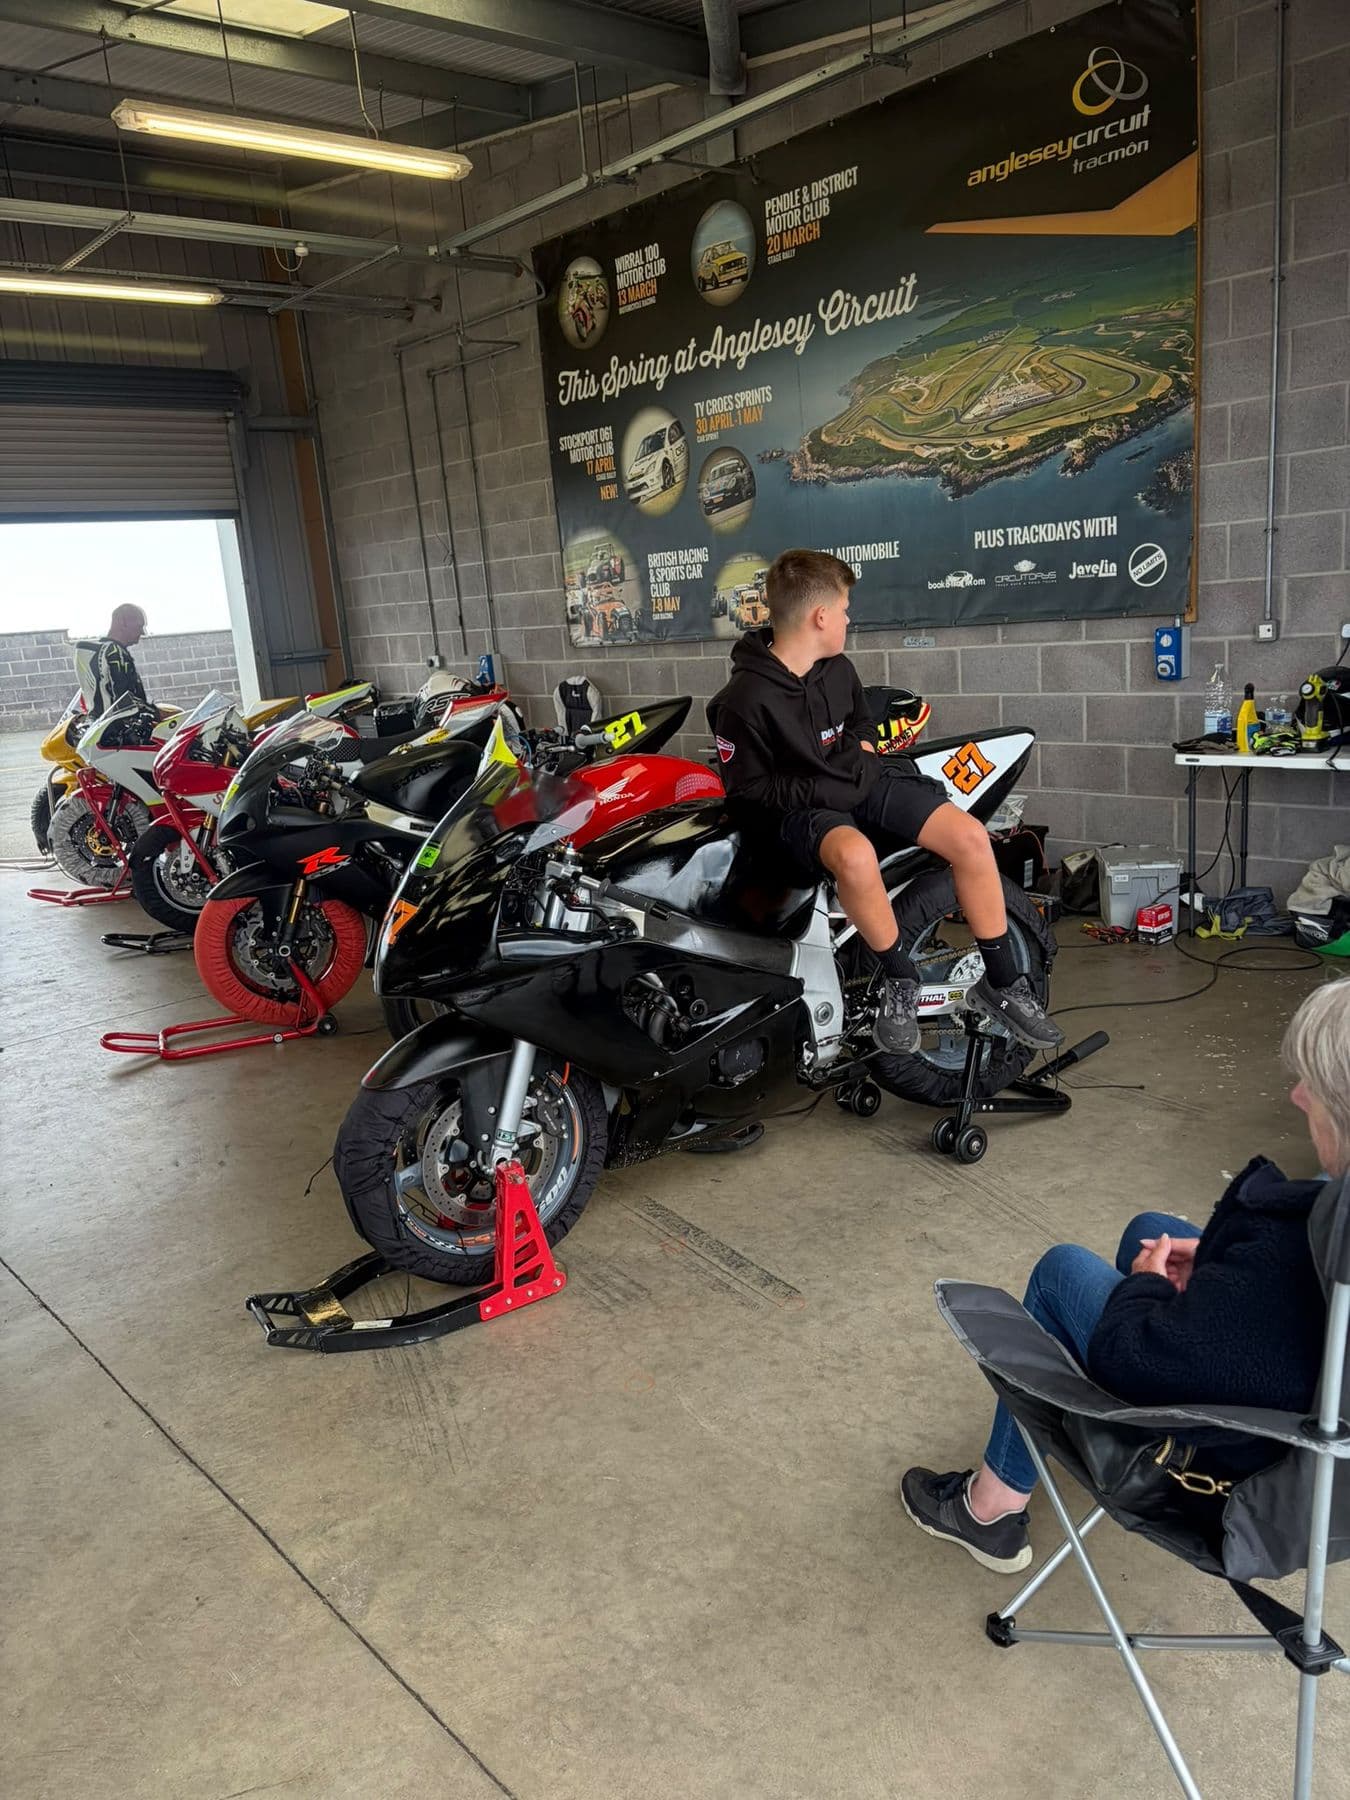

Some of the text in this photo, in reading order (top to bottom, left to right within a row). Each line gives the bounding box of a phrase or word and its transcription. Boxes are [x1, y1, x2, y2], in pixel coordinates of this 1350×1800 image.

[765, 166, 858, 218] PENDLE & DISTRICT
[766, 197, 831, 237] MOTOR CLUB
[767, 219, 820, 255] 20 MARCH
[615, 243, 660, 273] WIRRAL 100
[616, 257, 667, 291] MOTOR CLUB
[618, 278, 657, 306] 13 MARCH
[559, 272, 919, 406] This Spring at Anglesey Circuit
[694, 385, 773, 419] TY CROES SPRINTS
[696, 416, 708, 434] 30
[709, 411, 735, 432] APRIL
[743, 404, 764, 425] MAY
[559, 425, 613, 452] STOCKPORT 061
[569, 440, 614, 465] MOTOR CLUB
[595, 455, 616, 474] APRIL
[974, 516, 1118, 549] PLUS TRACKDAYS WITH
[647, 546, 709, 568] BRITISH RACING
[836, 541, 900, 563] AUTOMOBILE
[1133, 553, 1163, 578] NO LIMITS
[649, 563, 703, 583] & SPORTS CAR
[650, 582, 671, 598] CLUB
[651, 595, 681, 613] 7-8 MAY
[605, 711, 647, 749] 27
[941, 740, 997, 796] 27
[599, 792, 636, 806] HONDA
[385, 898, 419, 945] 7
[919, 993, 946, 1003] THAL
